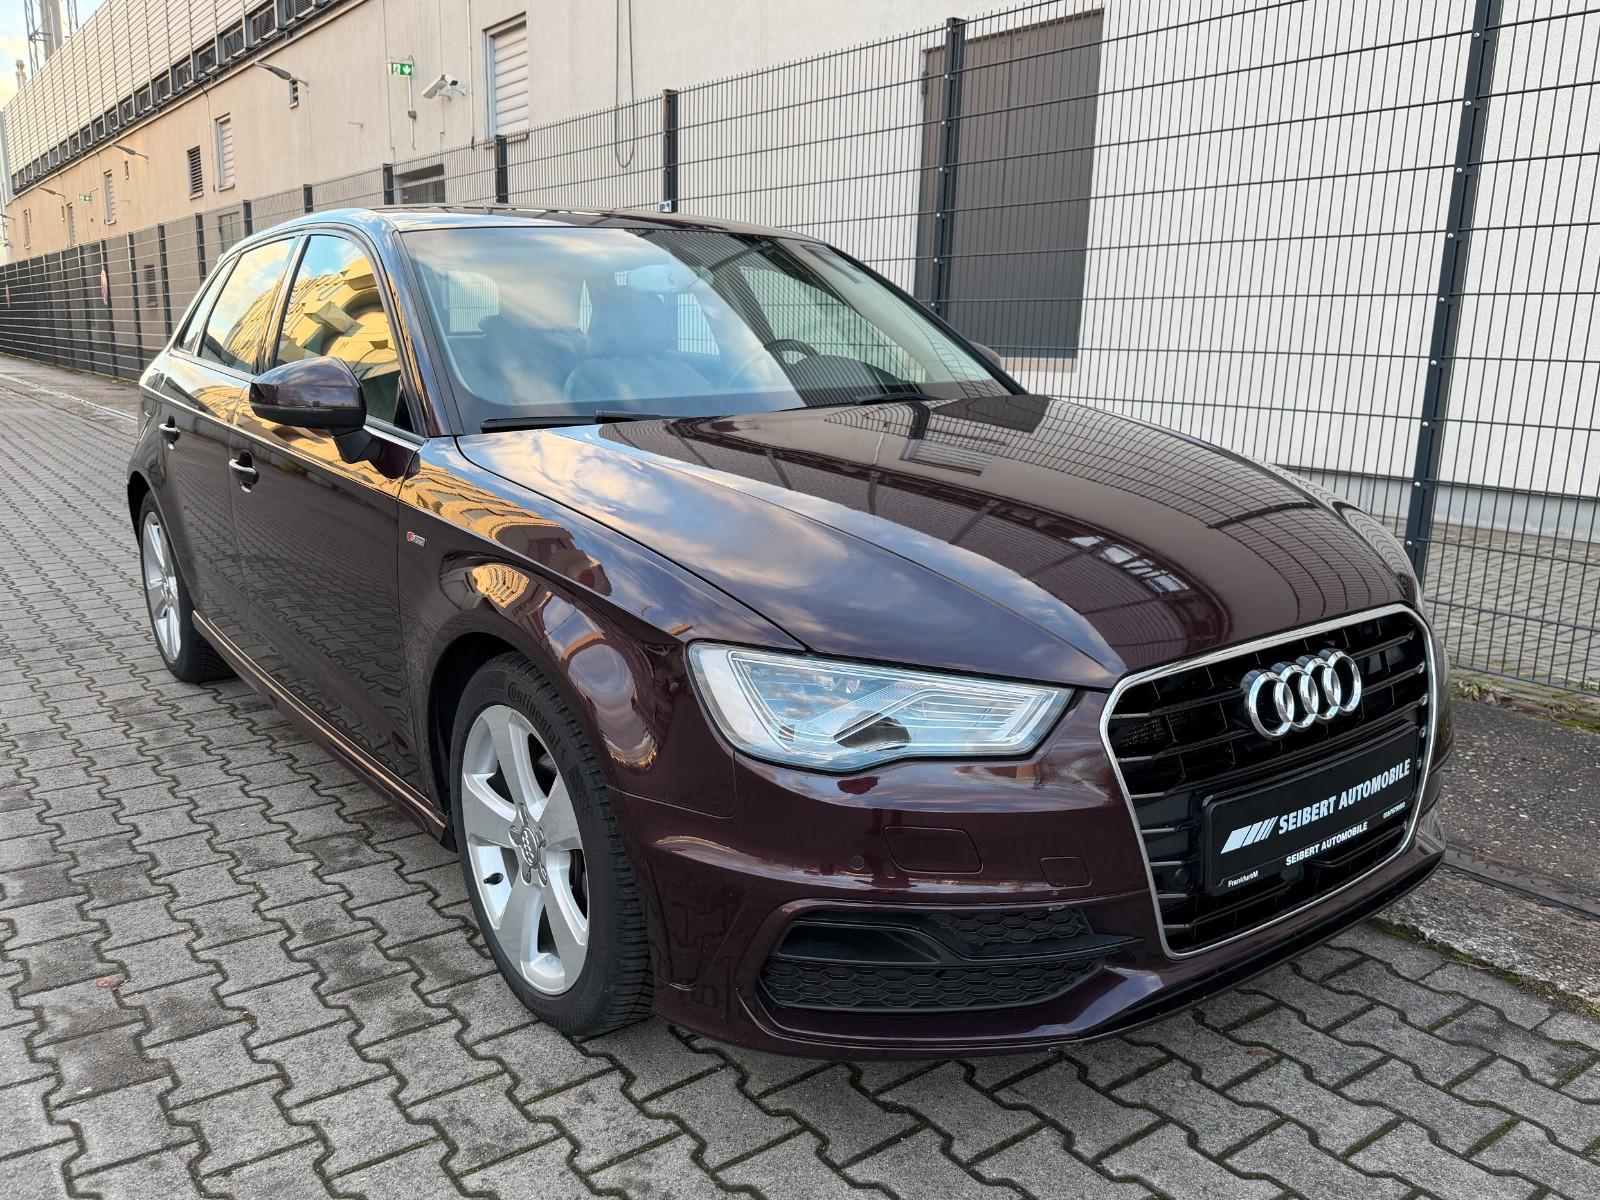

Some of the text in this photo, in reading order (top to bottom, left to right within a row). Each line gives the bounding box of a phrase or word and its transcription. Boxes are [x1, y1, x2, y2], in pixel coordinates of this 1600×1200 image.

[507, 682, 561, 750] Continental
[1278, 795, 1337, 834] SEIBERT
[1338, 758, 1411, 810] AUTOMOBILE
[1285, 821, 1369, 866] SEIBERT AUTOMOBILE
